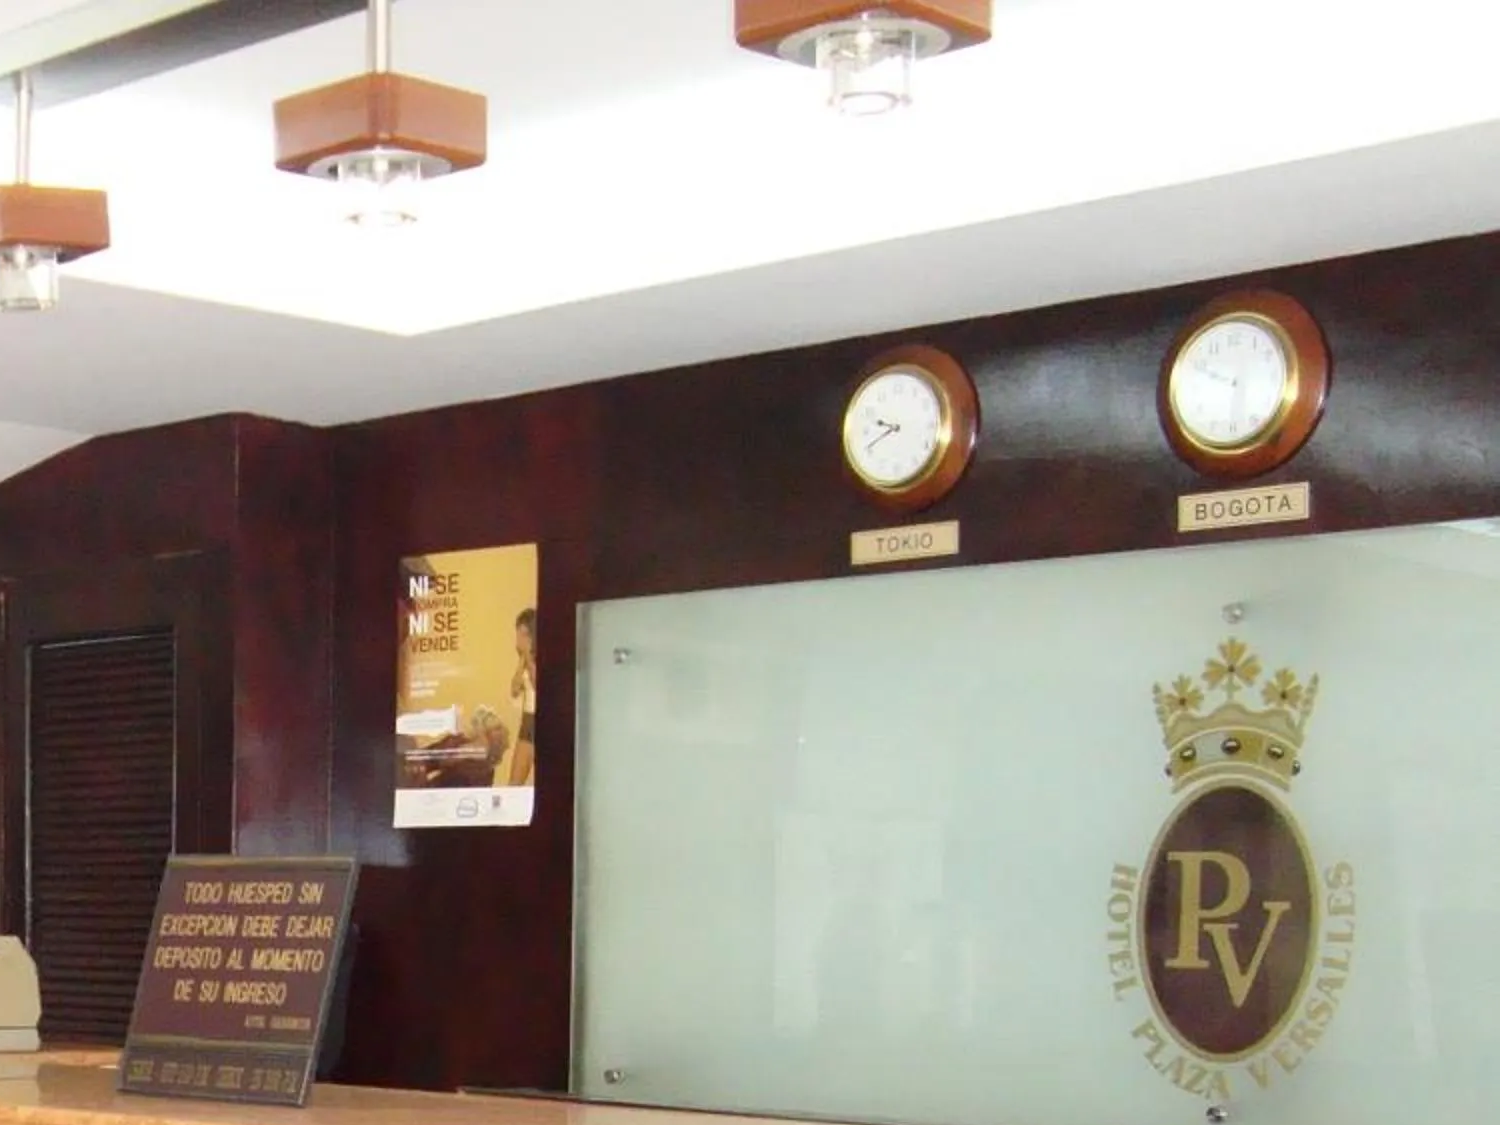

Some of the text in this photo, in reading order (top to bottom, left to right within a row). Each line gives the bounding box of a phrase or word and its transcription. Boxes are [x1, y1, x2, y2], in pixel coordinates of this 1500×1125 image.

[1194, 494, 1292, 521] BOGOTA
[875, 532, 934, 554] TOKIO
[409, 573, 460, 597] NI SE
[409, 611, 459, 636] NI SE
[410, 635, 460, 654] VENDE
[184, 881, 325, 905] TODO HUESPED SIN
[159, 913, 335, 938] EXCEPCION DEBE DEJAR
[153, 946, 325, 972] DEPOSITO AL MOMENTO
[173, 979, 288, 1006] DE SU INGRESO
[1106, 860, 1357, 1102] HOTEL PLAZA VERSALLES
